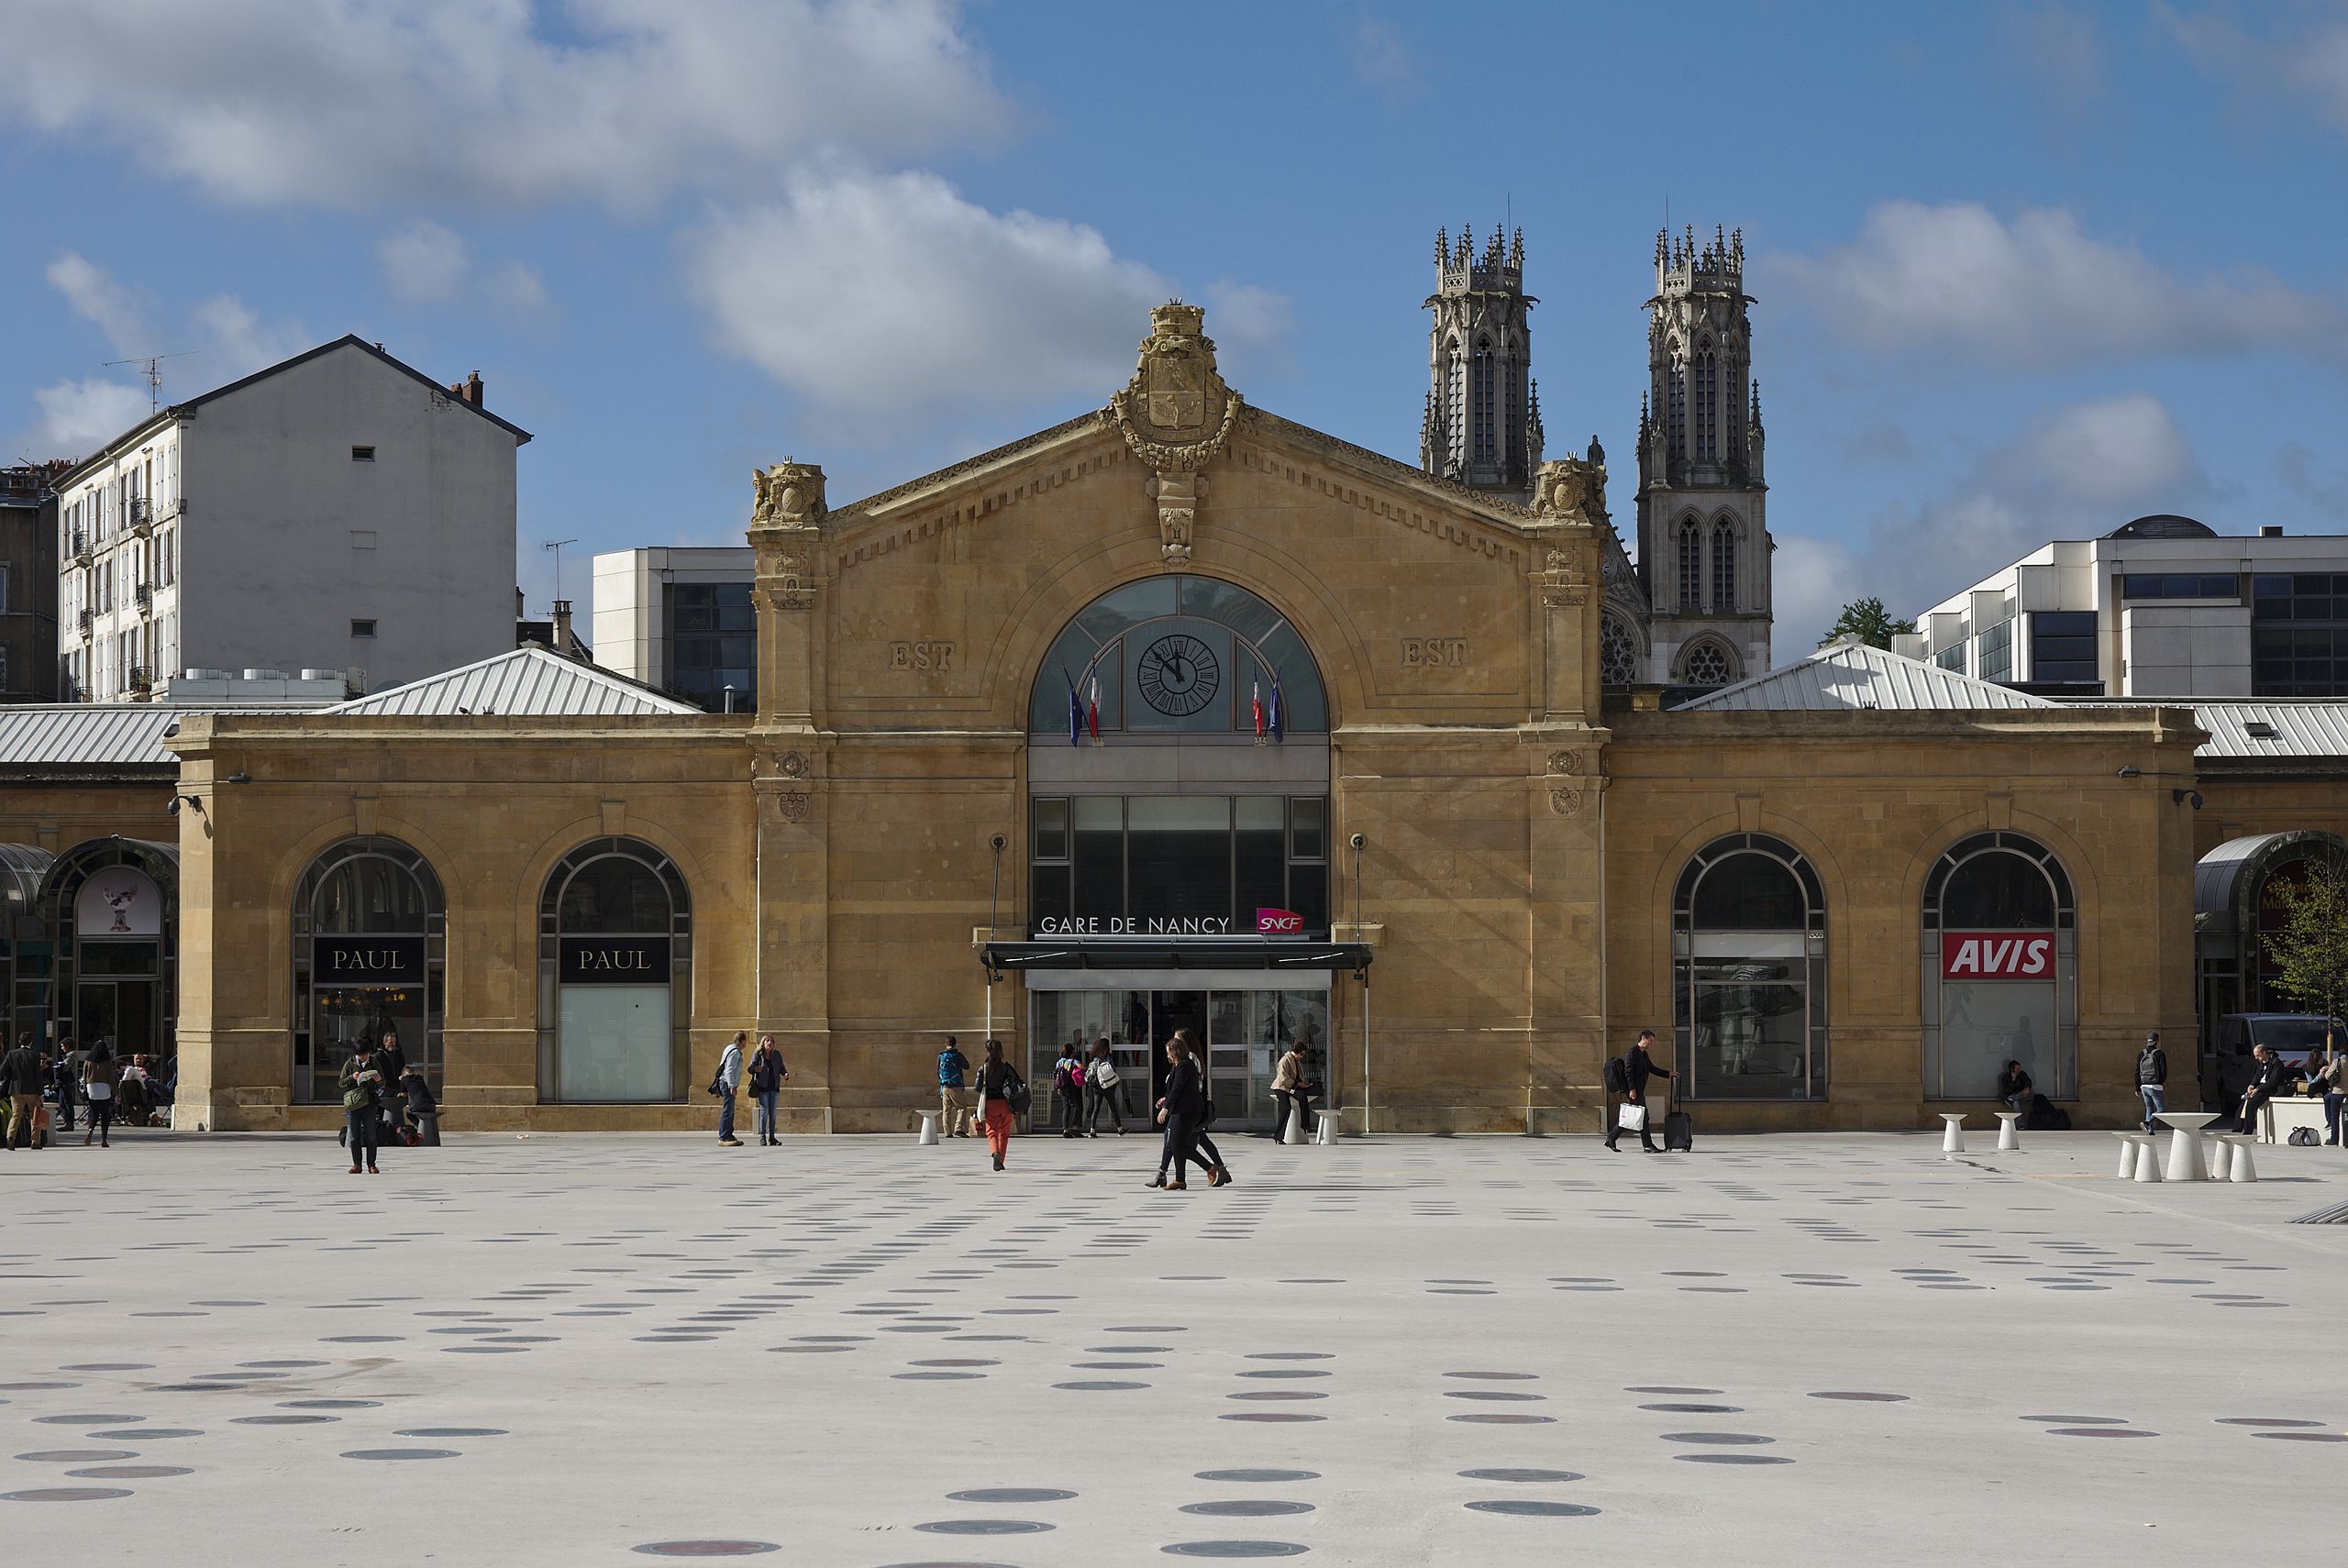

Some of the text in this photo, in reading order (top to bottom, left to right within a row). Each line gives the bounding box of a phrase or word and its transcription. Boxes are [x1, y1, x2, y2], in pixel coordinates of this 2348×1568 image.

[890, 641, 956, 670] EST
[1157, 644, 1170, 658] XI
[1190, 645, 1196, 657] I
[1401, 638, 1468, 667] EST
[1146, 656, 1161, 667] X
[1197, 657, 1210, 666] II
[1143, 671, 1157, 679] IX
[1200, 671, 1214, 679] III
[1146, 683, 1162, 699] VIII
[1158, 693, 1171, 709] VII
[1174, 697, 1183, 711] VI
[1190, 694, 1199, 708] V
[1041, 916, 1230, 933] GARE DE NANCY
[1259, 917, 1301, 930] SNCF
[333, 950, 406, 969] PAUL
[579, 950, 652, 969] PAUL
[1950, 939, 2049, 974] AVIS
